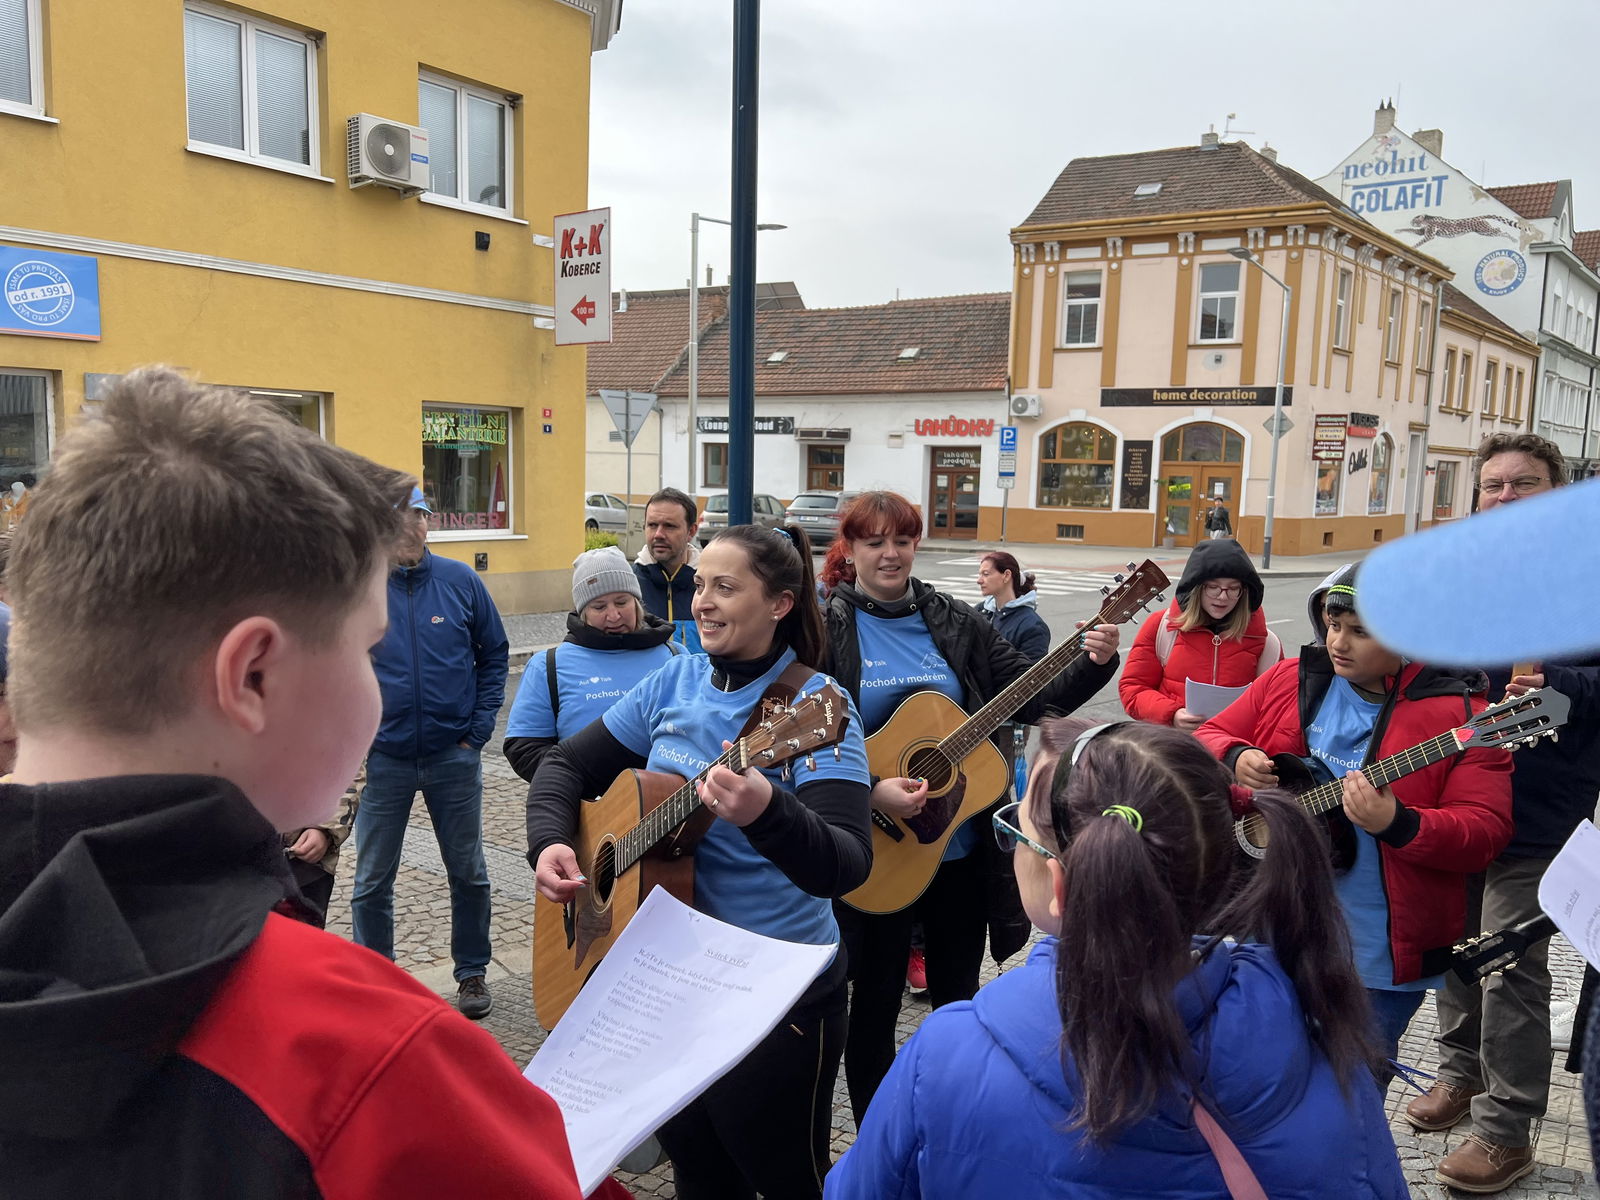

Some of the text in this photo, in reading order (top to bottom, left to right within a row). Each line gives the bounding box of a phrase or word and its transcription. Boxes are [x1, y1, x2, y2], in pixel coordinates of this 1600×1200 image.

[560, 223, 604, 259] K+K
[31, 264, 47, 273] PRO
[14, 292, 28, 303] od
[40, 285, 67, 298] 1991
[1153, 388, 1257, 400] home decoration
[704, 421, 729, 431] Loung
[914, 414, 995, 437] LAHŮDKY
[1003, 429, 1014, 445] P
[429, 512, 501, 529] SINGER
[860, 676, 897, 688] Pochod
[906, 672, 947, 684] modrém
[585, 689, 620, 701] Pochod
[824, 699, 833, 725] Taylor
[656, 744, 689, 764] Pochod
[688, 758, 696, 766] v
[1322, 752, 1329, 760] v
